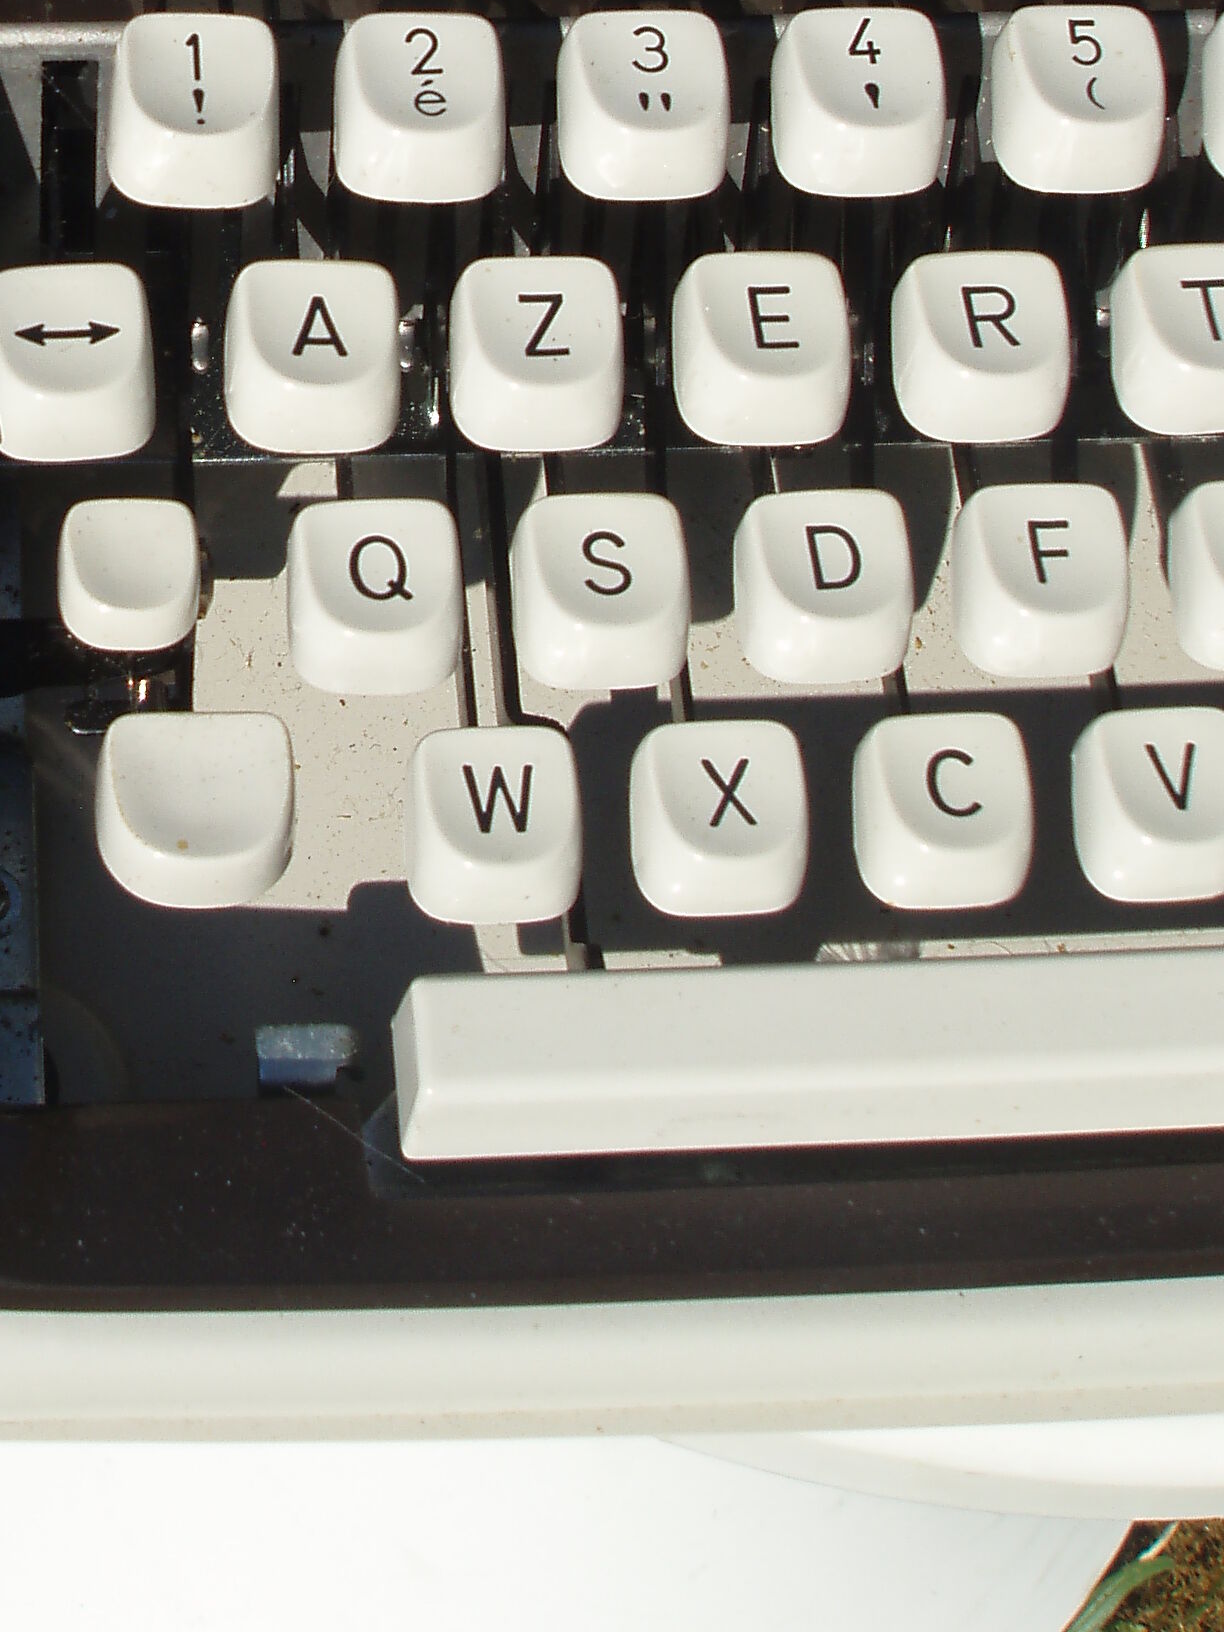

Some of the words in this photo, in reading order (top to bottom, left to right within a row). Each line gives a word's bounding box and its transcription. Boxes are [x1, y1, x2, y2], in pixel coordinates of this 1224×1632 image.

[182, 33, 203, 82] 1
[404, 27, 446, 76] 2
[630, 26, 672, 73] 3
[847, 17, 883, 65] 4
[1064, 19, 1104, 67] 5
[193, 88, 207, 124] !
[413, 79, 447, 117] é
[290, 294, 348, 357] A
[522, 292, 571, 358] Z
[751, 285, 799, 350] E
[967, 286, 1018, 348] R
[348, 534, 413, 602] Q
[581, 531, 632, 595] S
[808, 526, 861, 591] D
[1027, 520, 1069, 584] F
[461, 764, 533, 833] W
[702, 758, 757, 827] X
[925, 748, 983, 818] C
[1145, 743, 1197, 811] V
